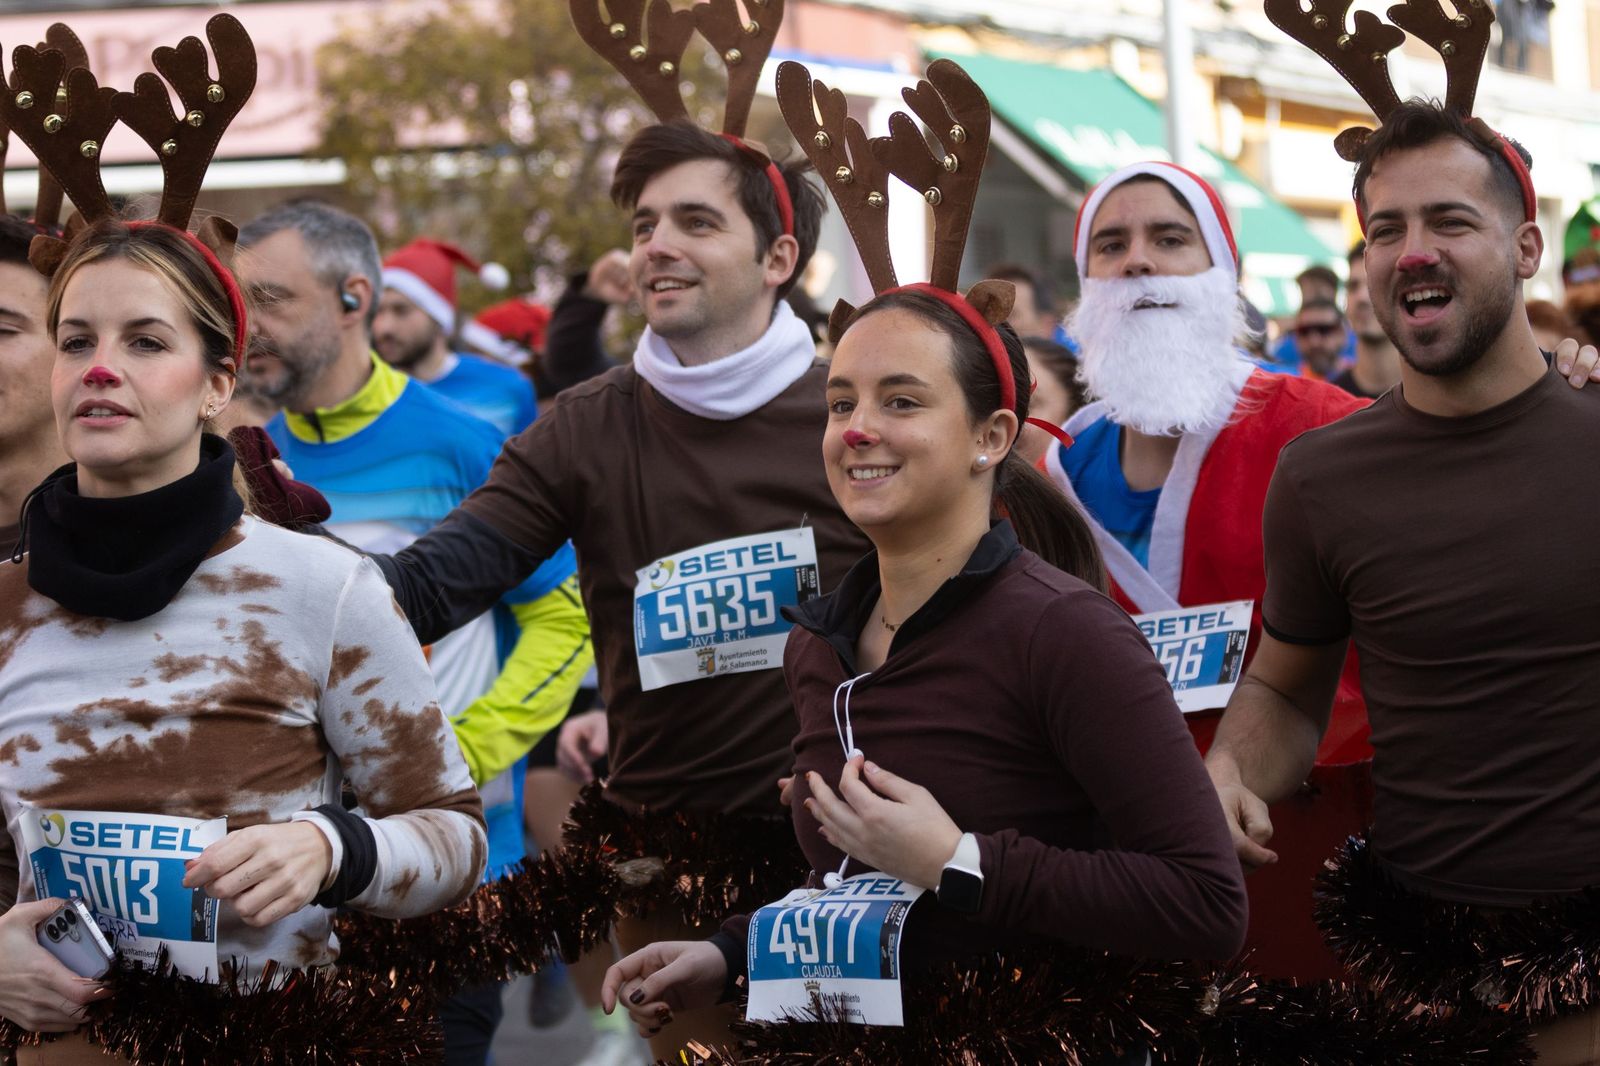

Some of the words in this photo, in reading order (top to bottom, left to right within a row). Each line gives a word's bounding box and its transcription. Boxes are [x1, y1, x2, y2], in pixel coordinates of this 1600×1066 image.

[679, 541, 797, 577] SETEL
[657, 571, 776, 641] 5635
[1137, 611, 1234, 638] SETEL
[687, 634, 716, 649] JAVI
[719, 648, 768, 661] Ayuntamiento
[719, 663, 728, 672] de
[729, 658, 768, 670] Salamanca
[1152, 636, 1207, 682] 56
[70, 821, 204, 852] SETEL
[60, 852, 159, 925] 5013
[769, 902, 871, 964] 4977
[801, 965, 843, 978] CLAUDIA
